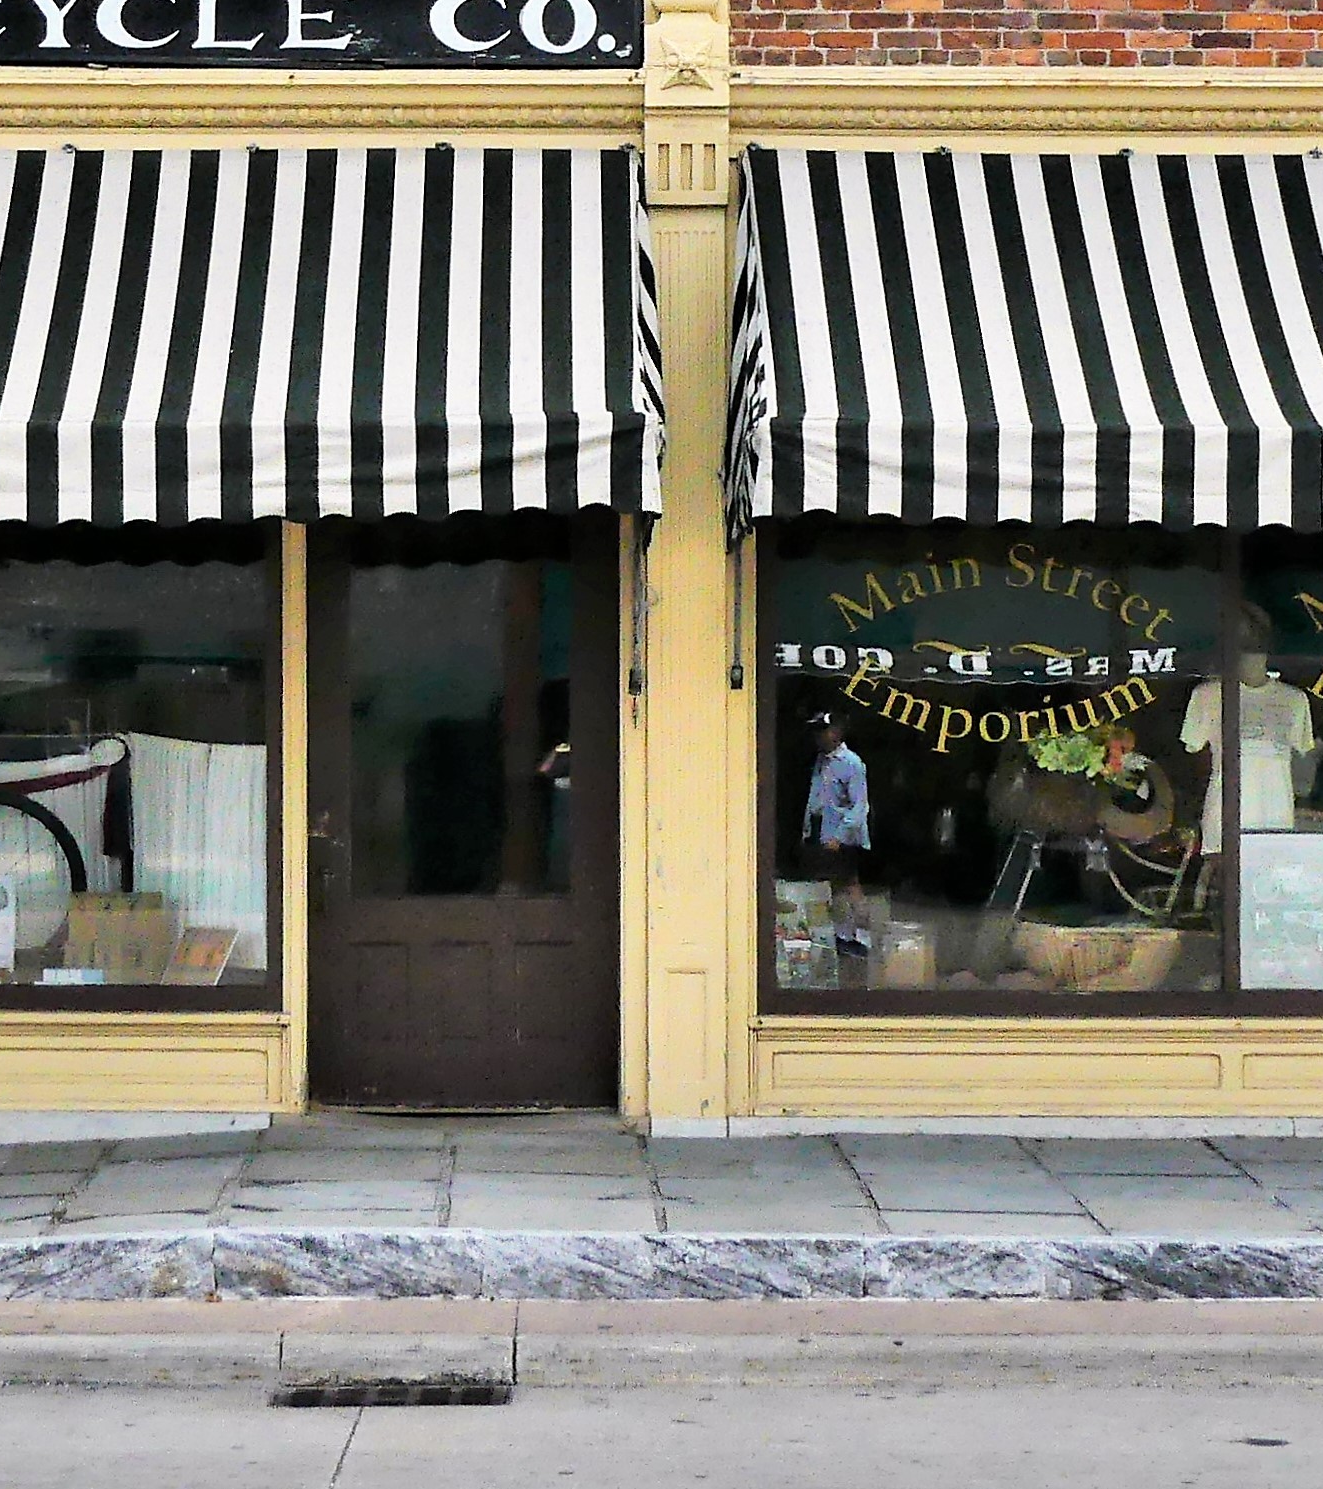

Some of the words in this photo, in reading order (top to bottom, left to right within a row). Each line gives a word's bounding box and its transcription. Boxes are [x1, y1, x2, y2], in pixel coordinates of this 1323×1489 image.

[828, 552, 984, 633] Main
[1005, 543, 1173, 642] Street
[839, 657, 1157, 753] Emporium
